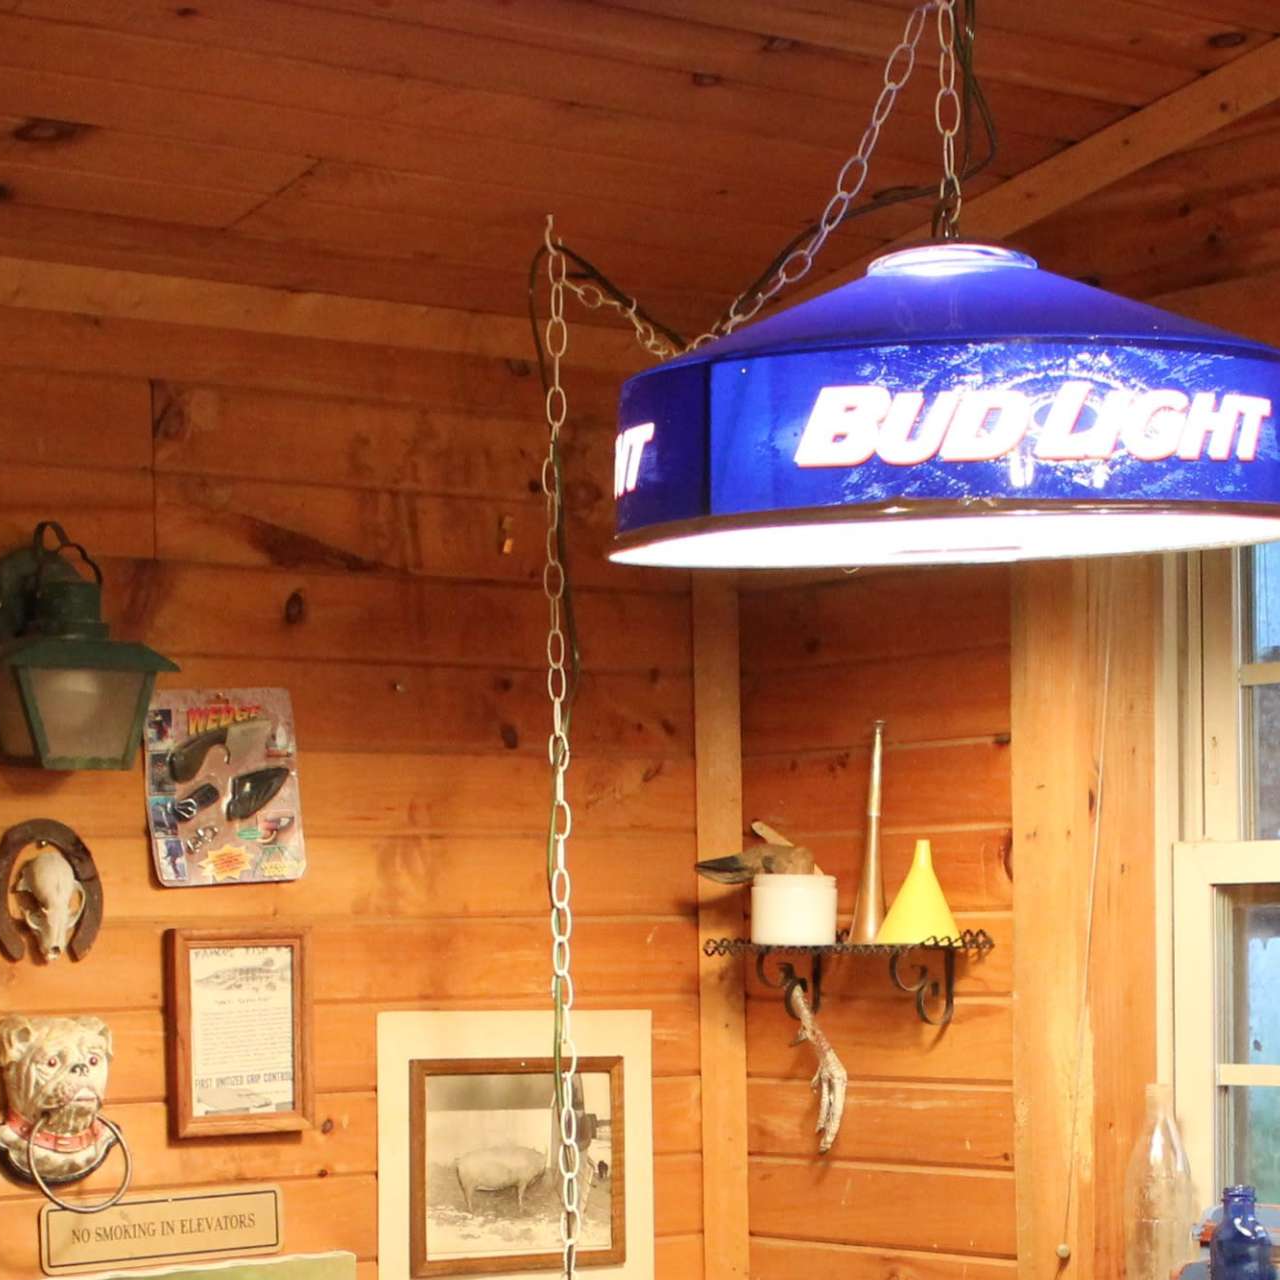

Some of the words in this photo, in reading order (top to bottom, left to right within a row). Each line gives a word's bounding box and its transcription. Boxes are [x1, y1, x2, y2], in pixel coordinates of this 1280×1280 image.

[794, 384, 1028, 468] BUD
[1034, 380, 1272, 462] LIGHT
[71, 1228, 91, 1244] NO
[95, 1221, 157, 1242] SMOKING
[161, 1219, 176, 1236] IN
[180, 1213, 257, 1235] ELEVATORS
